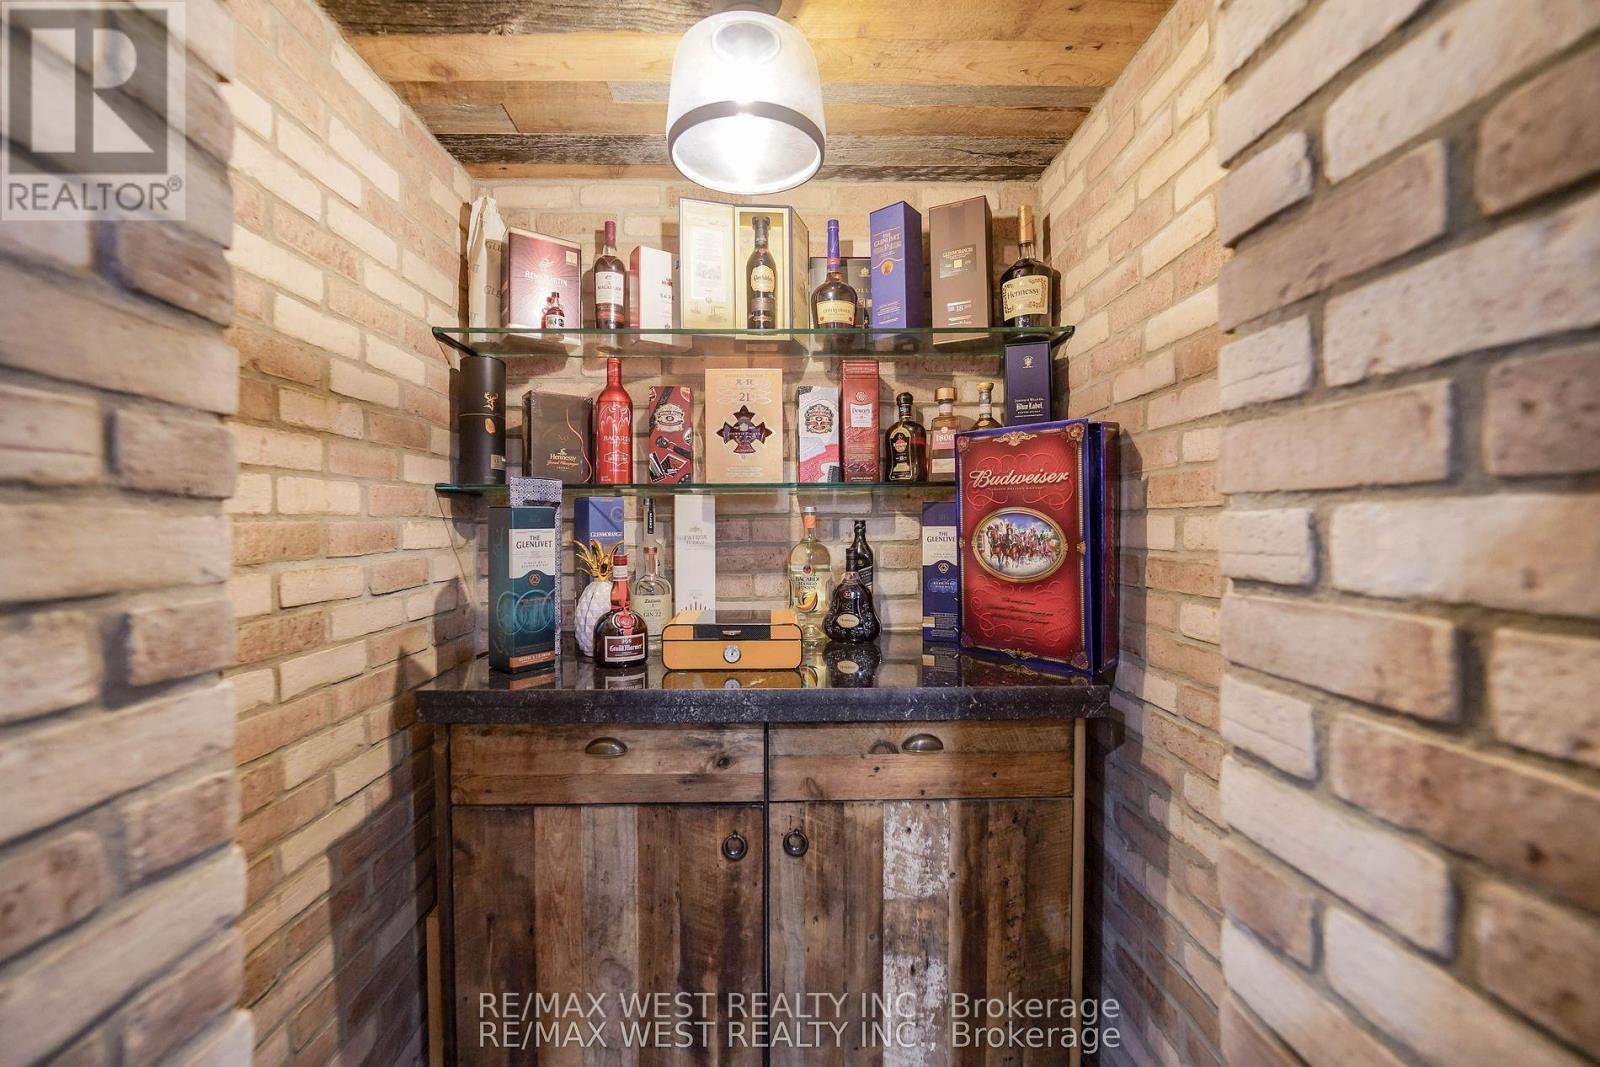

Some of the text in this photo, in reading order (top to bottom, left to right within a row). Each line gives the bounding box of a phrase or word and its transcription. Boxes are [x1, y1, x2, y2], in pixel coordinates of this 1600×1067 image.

[1006, 288, 1041, 300] Hennessy
[739, 392, 751, 402] 21
[935, 433, 955, 442] 1800
[550, 453, 577, 463] Hennessy
[969, 467, 1069, 489] Budweiser
[516, 540, 553, 550] GLENLIVET
